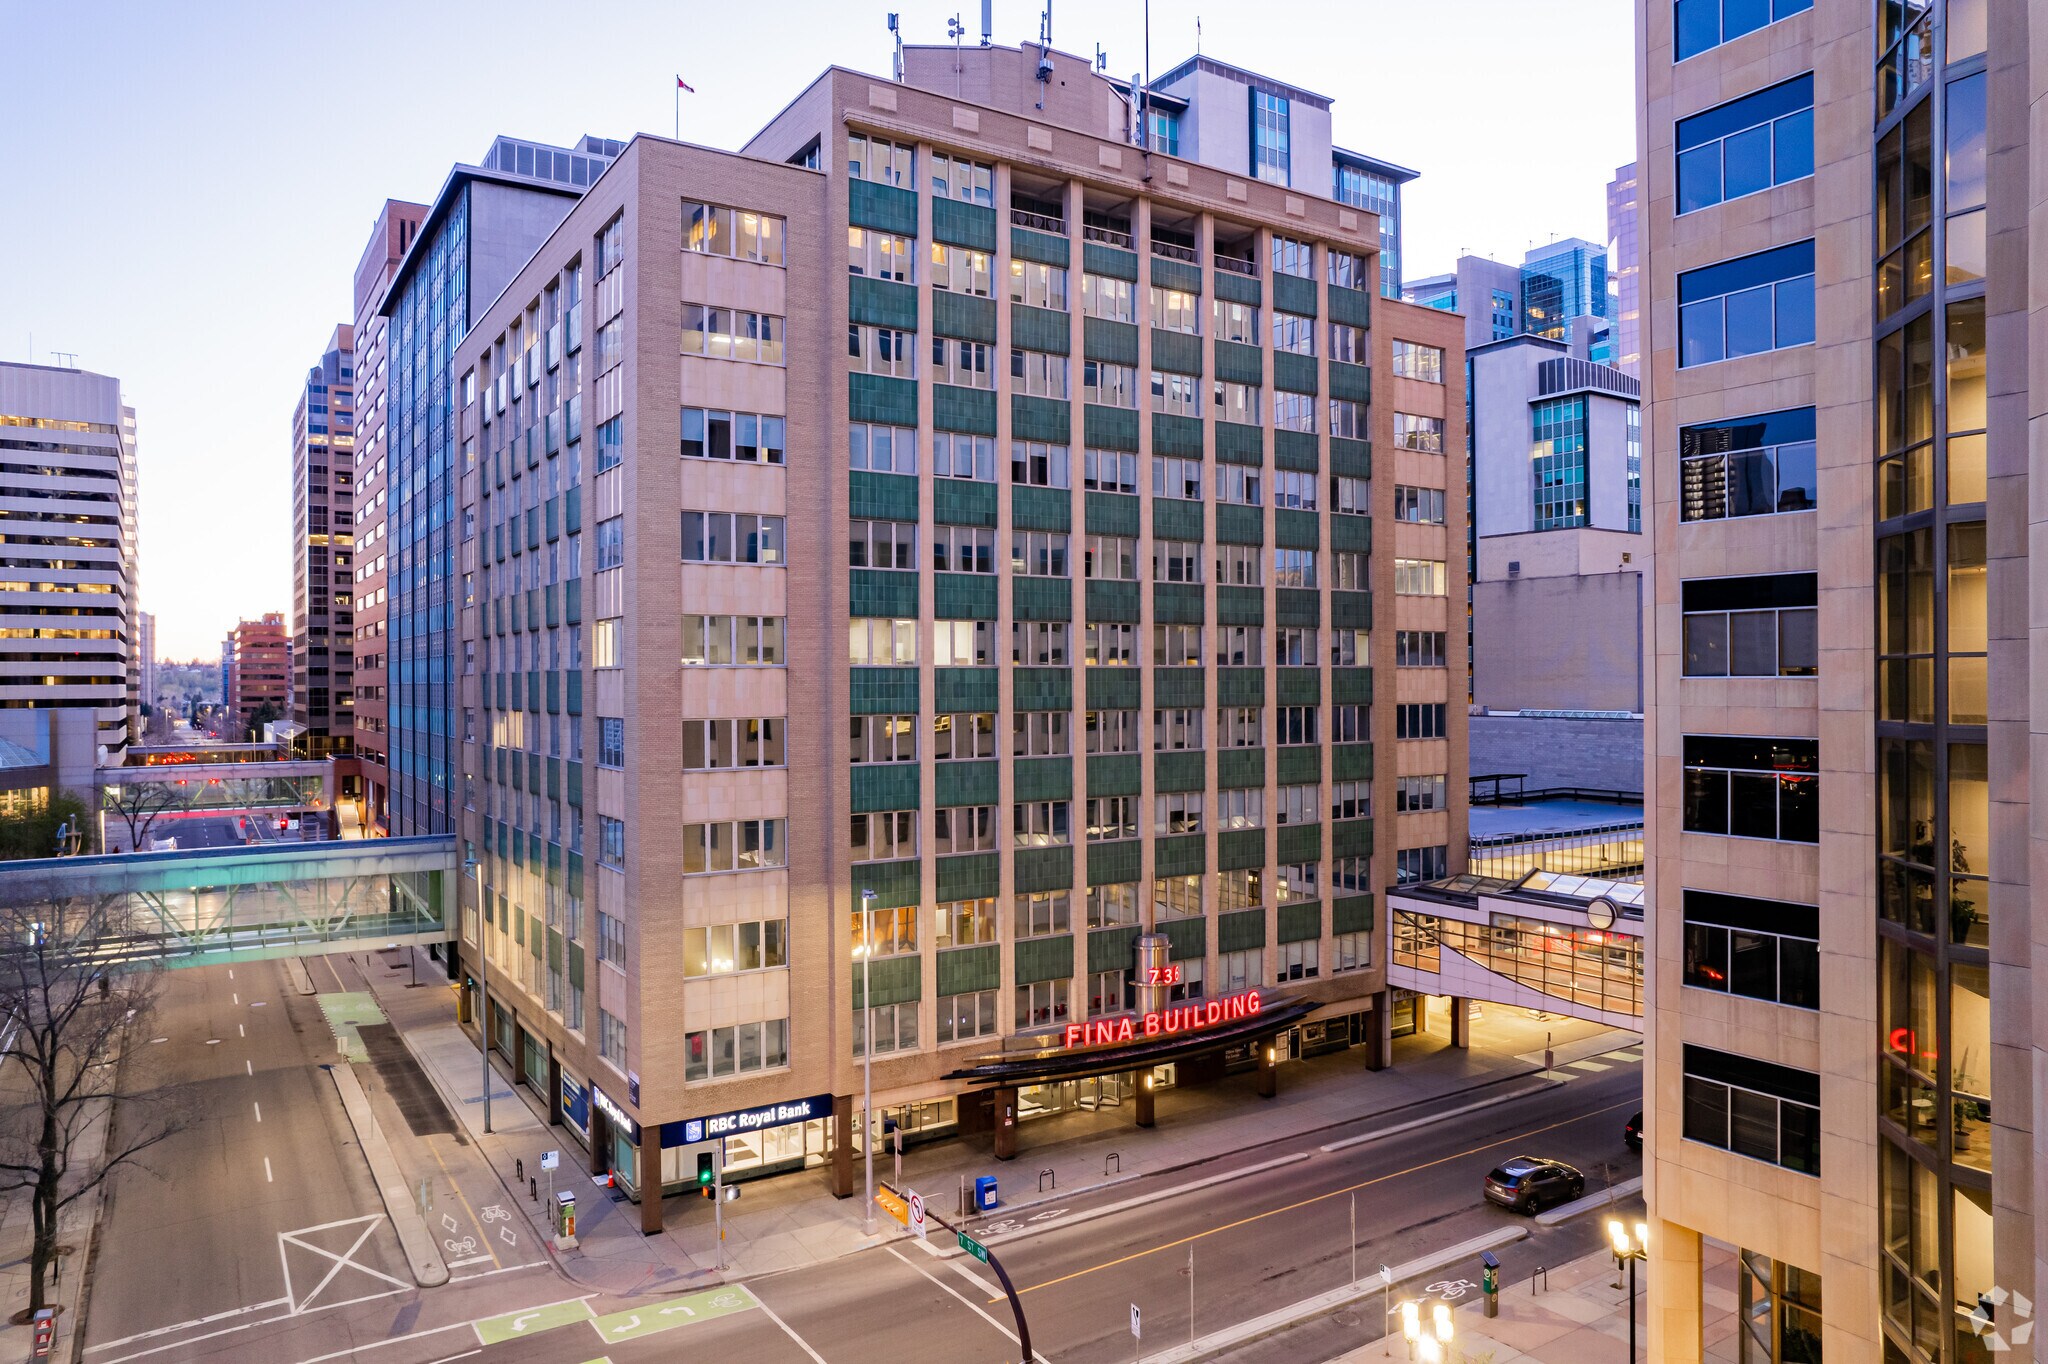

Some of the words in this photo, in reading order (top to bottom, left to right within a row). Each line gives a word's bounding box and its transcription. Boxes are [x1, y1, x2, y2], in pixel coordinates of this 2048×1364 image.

[1149, 966, 1180, 985] 736
[1065, 1018, 1134, 1049] FINA
[1144, 991, 1261, 1036] BUILDING
[709, 1115, 737, 1134] RBC
[739, 1107, 776, 1128] Royal
[778, 1101, 811, 1121] Bank
[959, 1235, 964, 1244] 7
[967, 1241, 974, 1252] ST
[977, 1248, 986, 1260] SW
